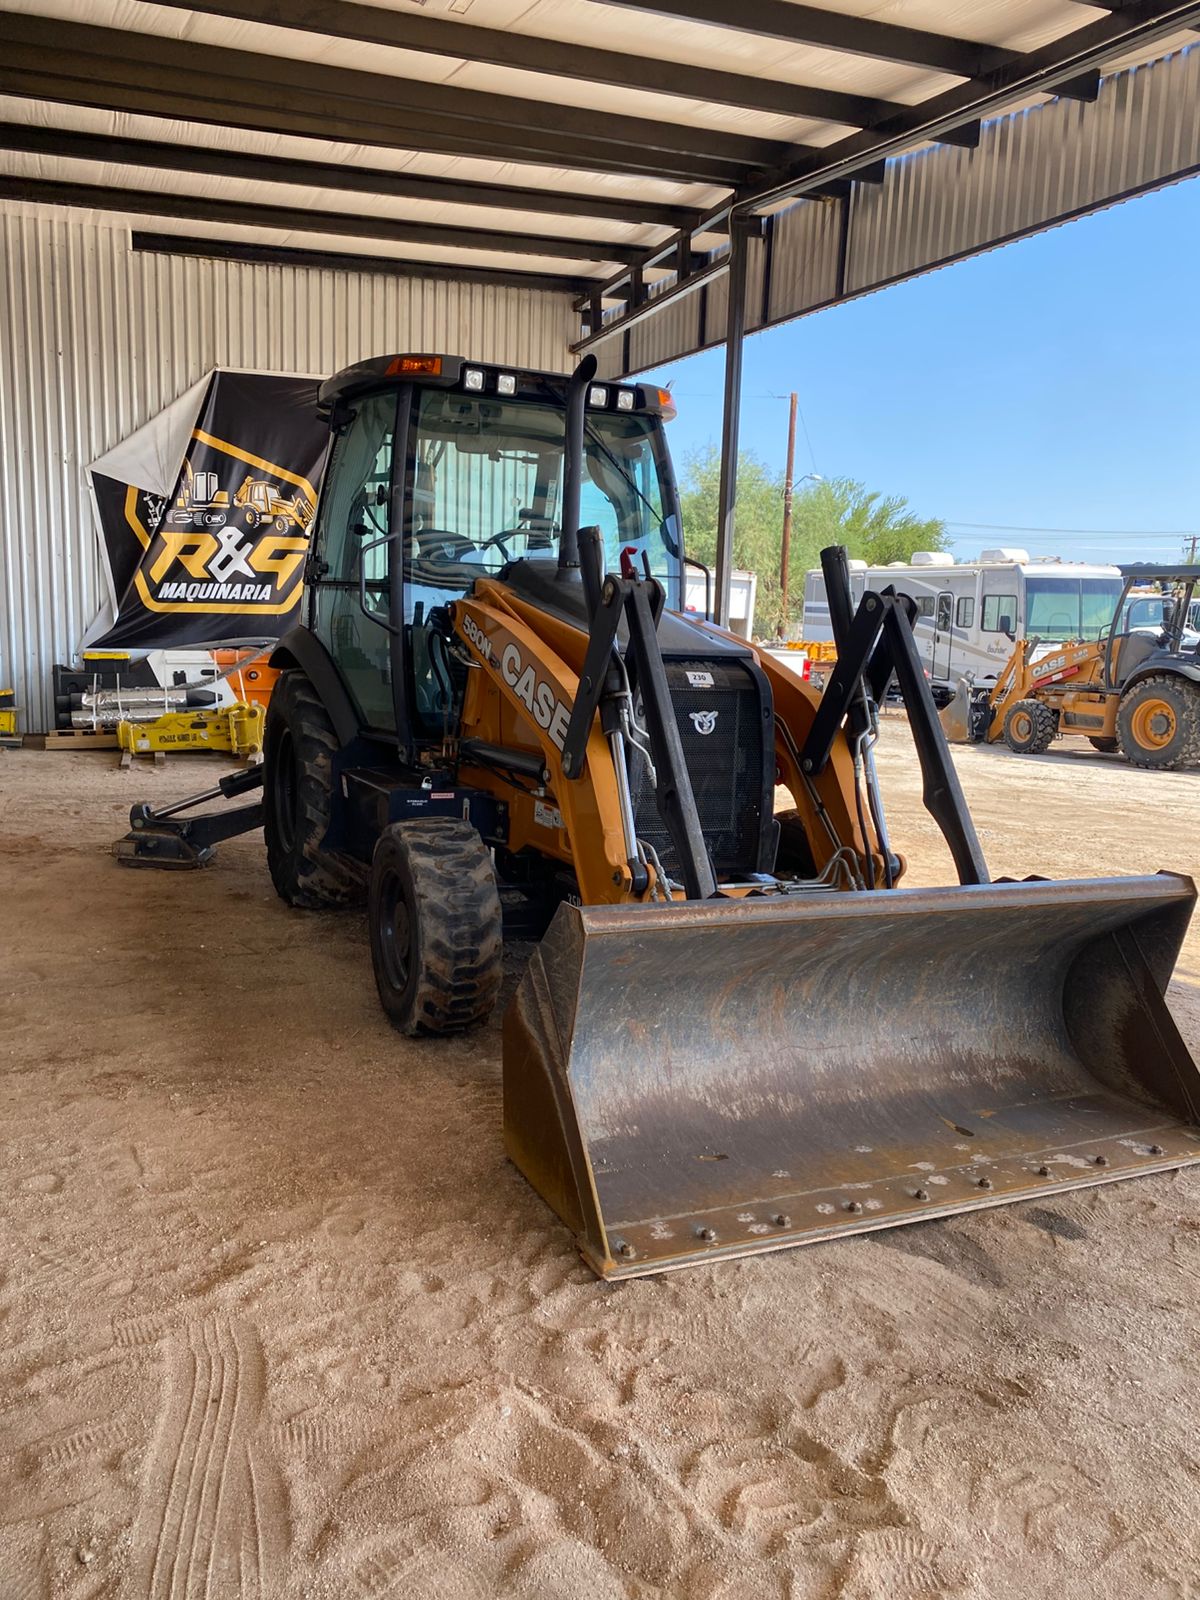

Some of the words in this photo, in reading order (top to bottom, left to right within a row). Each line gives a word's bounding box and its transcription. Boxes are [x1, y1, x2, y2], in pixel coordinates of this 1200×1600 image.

[157, 582, 273, 601] MAQUINARIA
[462, 614, 492, 661] 580N
[1031, 655, 1067, 678] CASE
[501, 643, 572, 753] CASE
